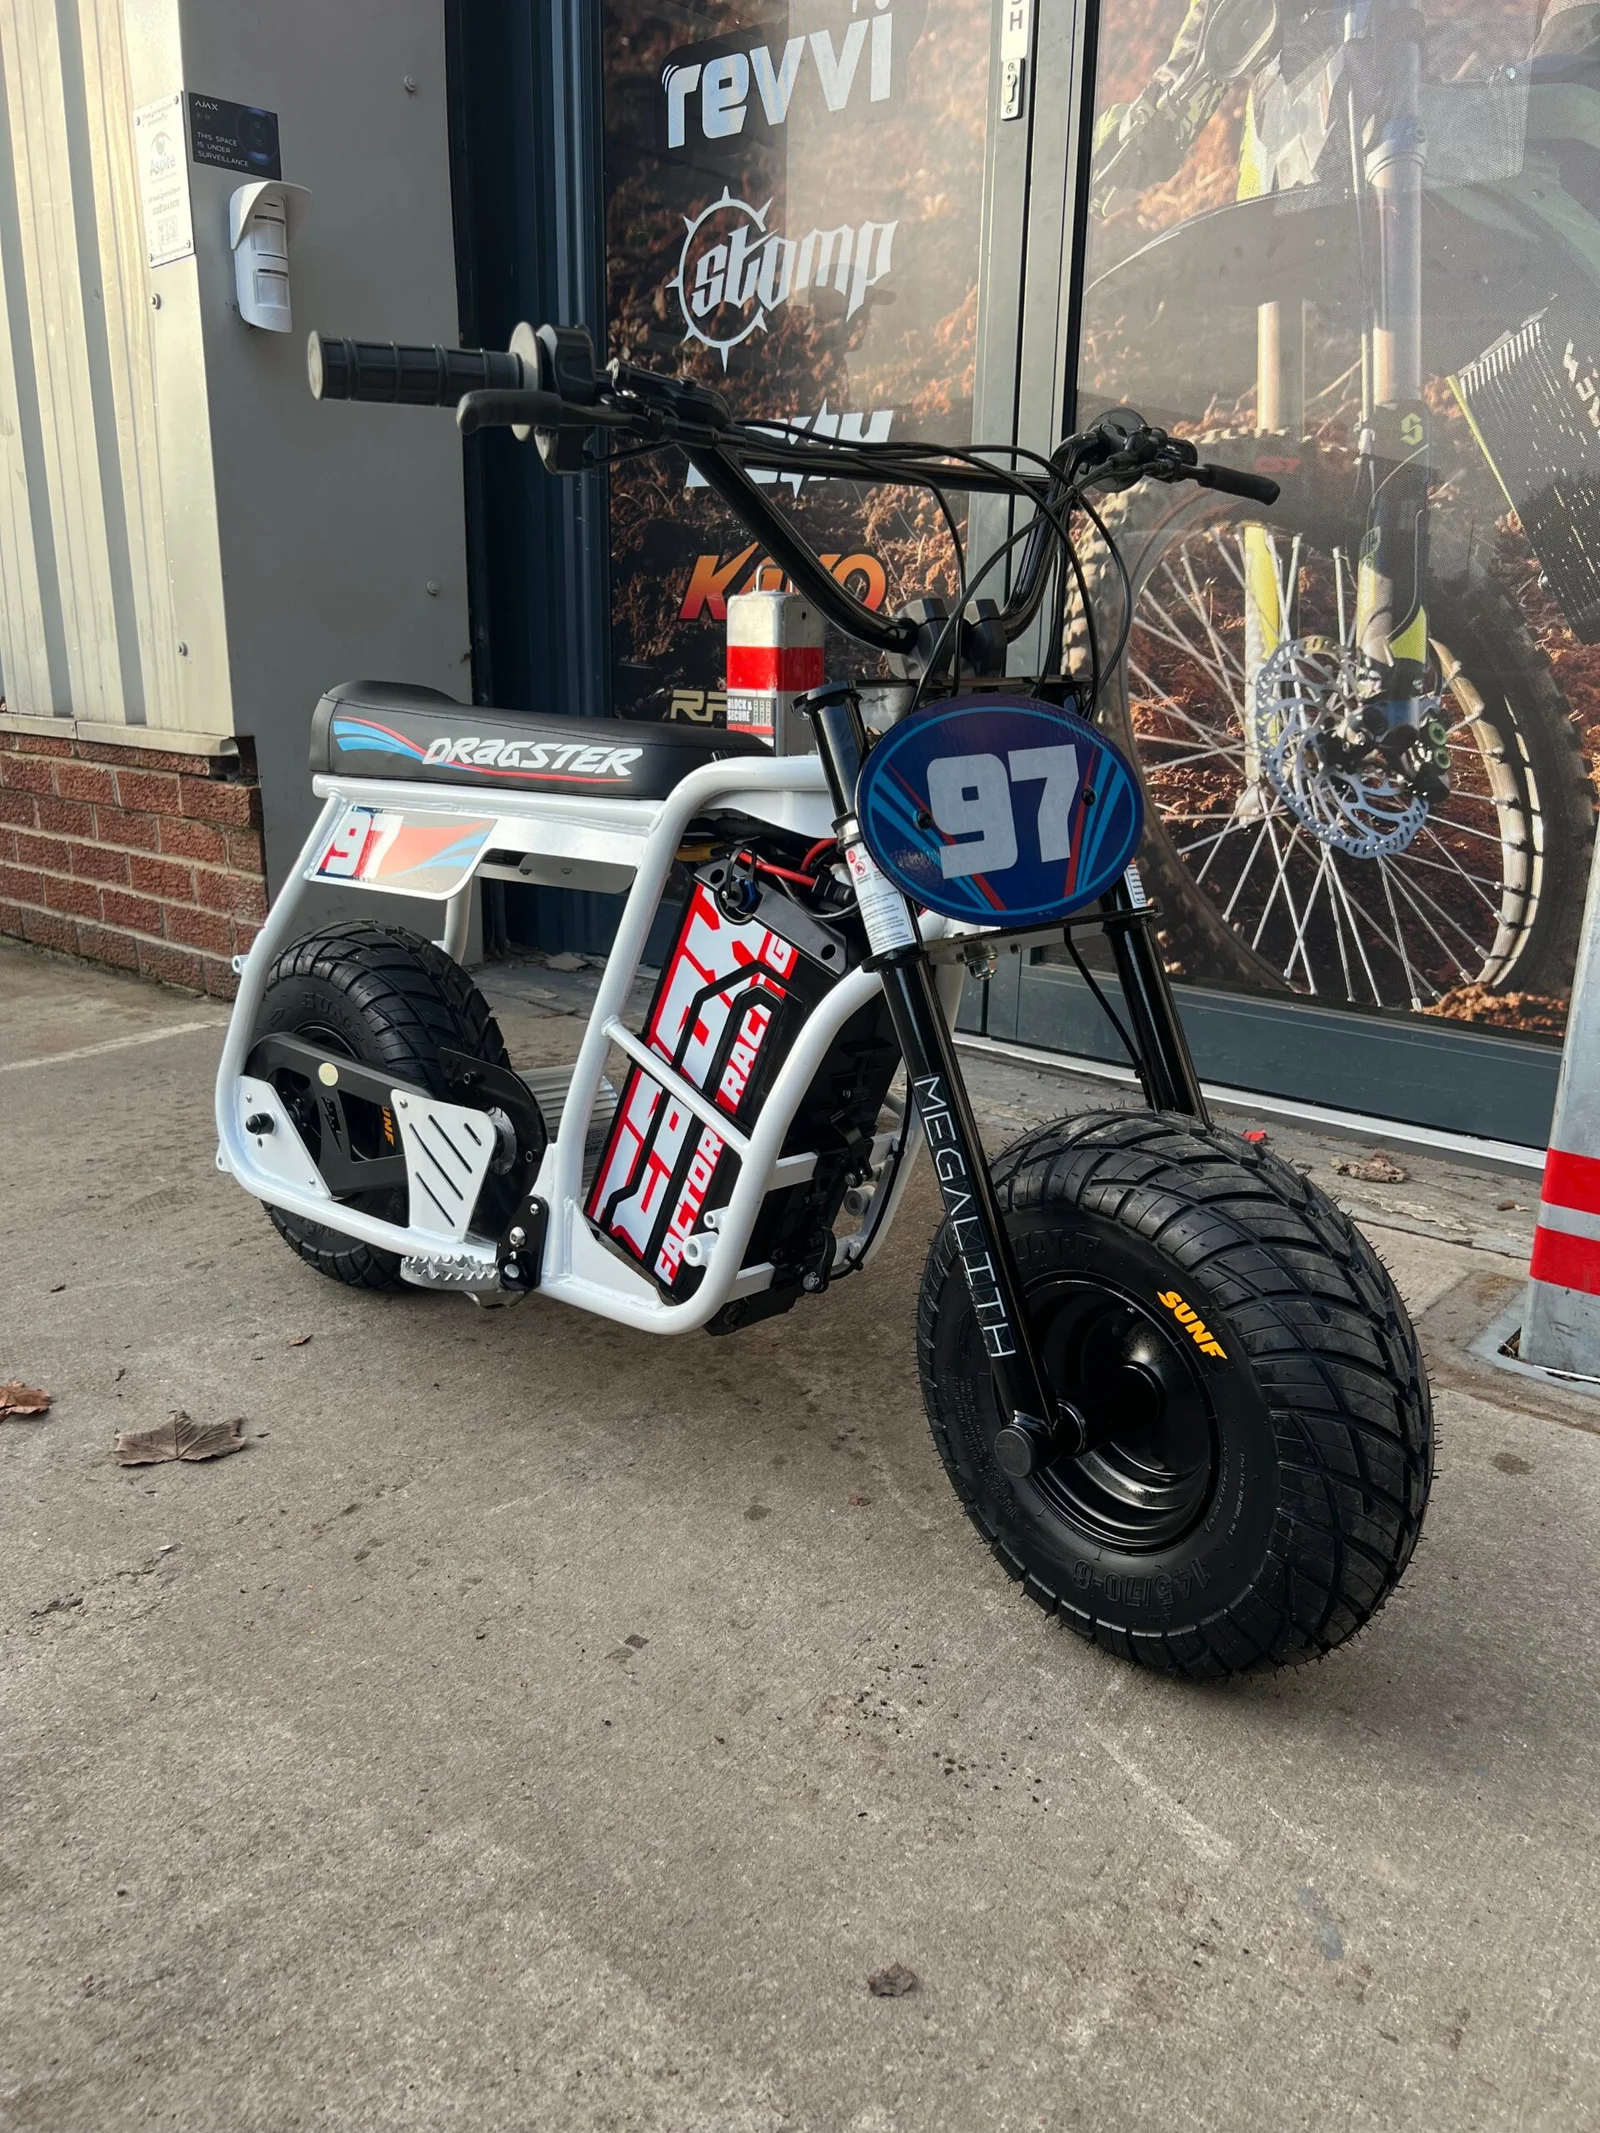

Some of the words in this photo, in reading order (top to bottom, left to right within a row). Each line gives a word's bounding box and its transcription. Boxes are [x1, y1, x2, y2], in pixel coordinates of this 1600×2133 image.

[195, 100, 219, 111] AJAX
[662, 12, 893, 149] revvi
[197, 131, 213, 141] THIS
[215, 136, 238, 147] SPACE
[197, 141, 205, 149] IS
[207, 144, 231, 154] UNDER
[198, 151, 249, 168] SURVEILLANCE
[679, 541, 887, 620] KAO
[727, 710, 751, 722] SECURE
[324, 811, 404, 880] 97
[927, 743, 1080, 879] 97
[381, 1105, 395, 1148] UNF
[654, 1125, 726, 1286] FACTOR
[914, 1076, 1016, 1357] MEGALITH
[1157, 1290, 1229, 1360] SUNF
